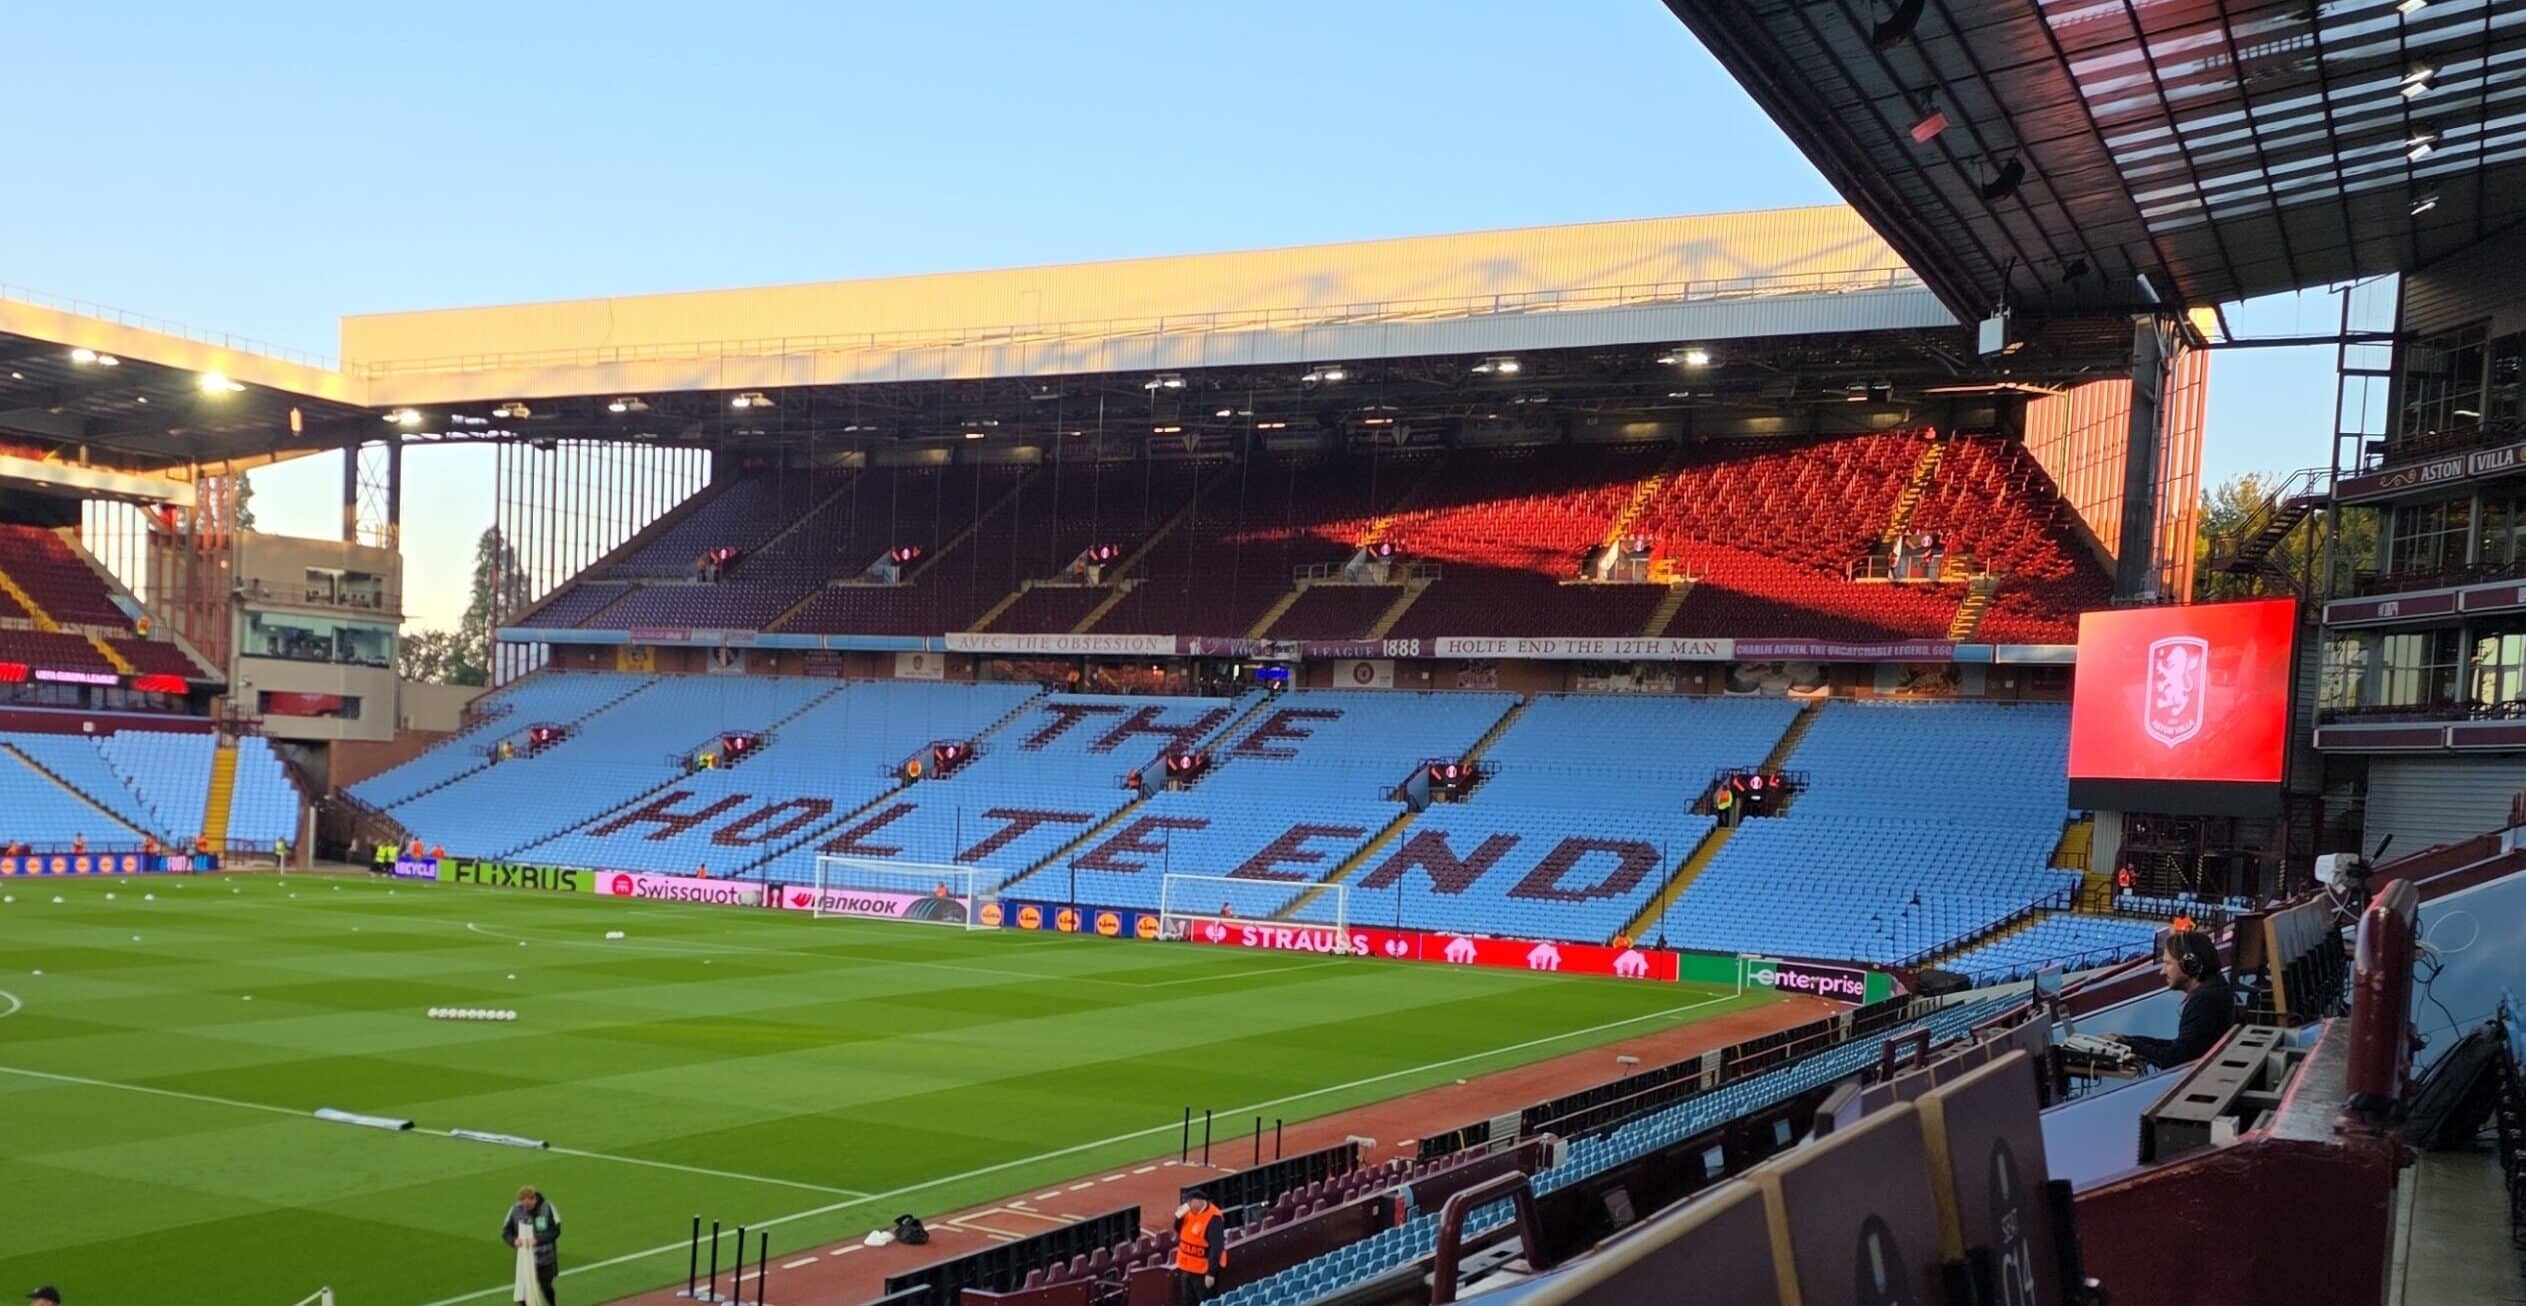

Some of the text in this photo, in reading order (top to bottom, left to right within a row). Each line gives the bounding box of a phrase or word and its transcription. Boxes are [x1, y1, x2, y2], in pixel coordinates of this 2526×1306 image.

[2420, 450, 2514, 482] ASTON VILLA
[959, 635, 1158, 650] AVFC THE OBSESSION
[1382, 639, 1420, 657] 1888
[1448, 640, 1718, 655] HOLTE END THE 12TH MAN
[1018, 703, 1344, 758] THE
[586, 790, 1662, 904] HOLTE END
[637, 877, 750, 905] Swissquot
